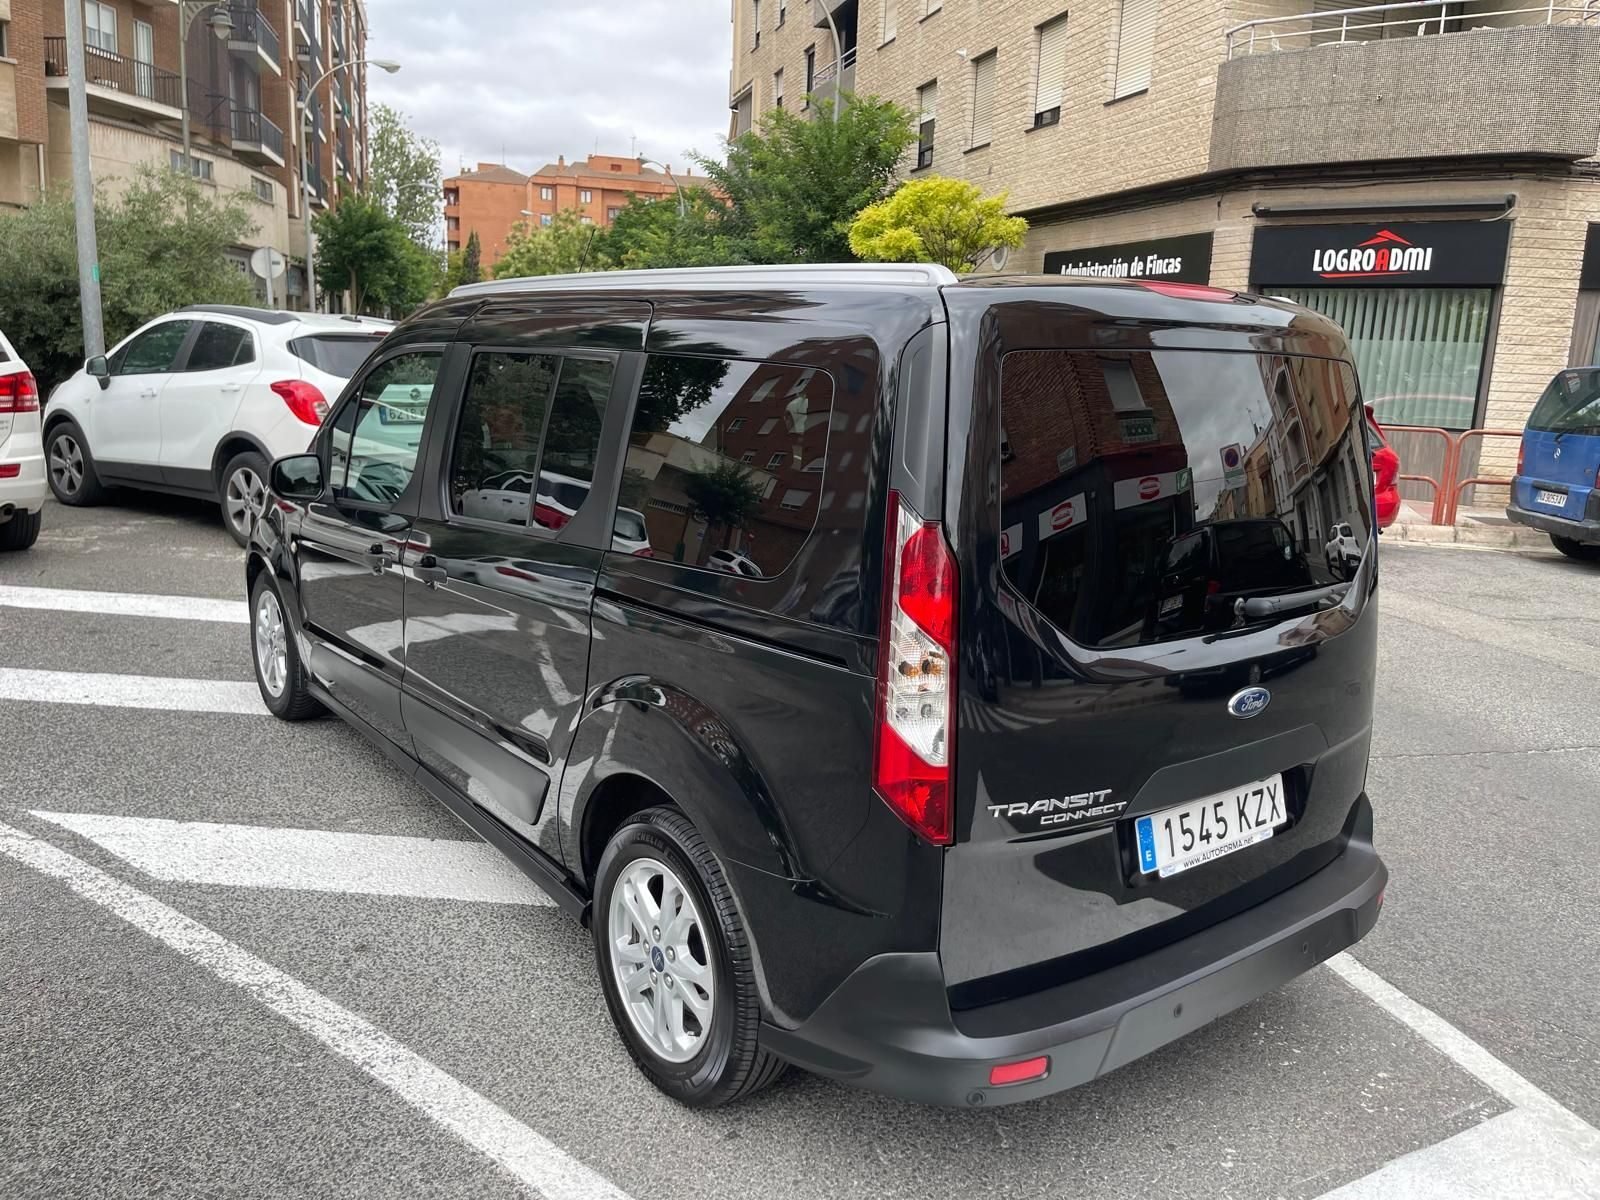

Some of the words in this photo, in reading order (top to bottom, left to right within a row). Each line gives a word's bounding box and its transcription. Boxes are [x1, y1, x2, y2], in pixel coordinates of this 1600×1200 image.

[1060, 257, 1129, 278] Administración
[1130, 256, 1144, 276] de
[1145, 254, 1182, 275] Fincas
[1312, 247, 1433, 272] LOGROADMI
[1241, 693, 1264, 712] Ford
[987, 788, 1113, 818] TRANSIT
[1040, 801, 1127, 825] CONNECT
[1164, 801, 1228, 858] 1545
[1236, 783, 1281, 833] KZX
[1145, 850, 1153, 862] E
[1183, 836, 1255, 868] www.AUTOFORMA.net
